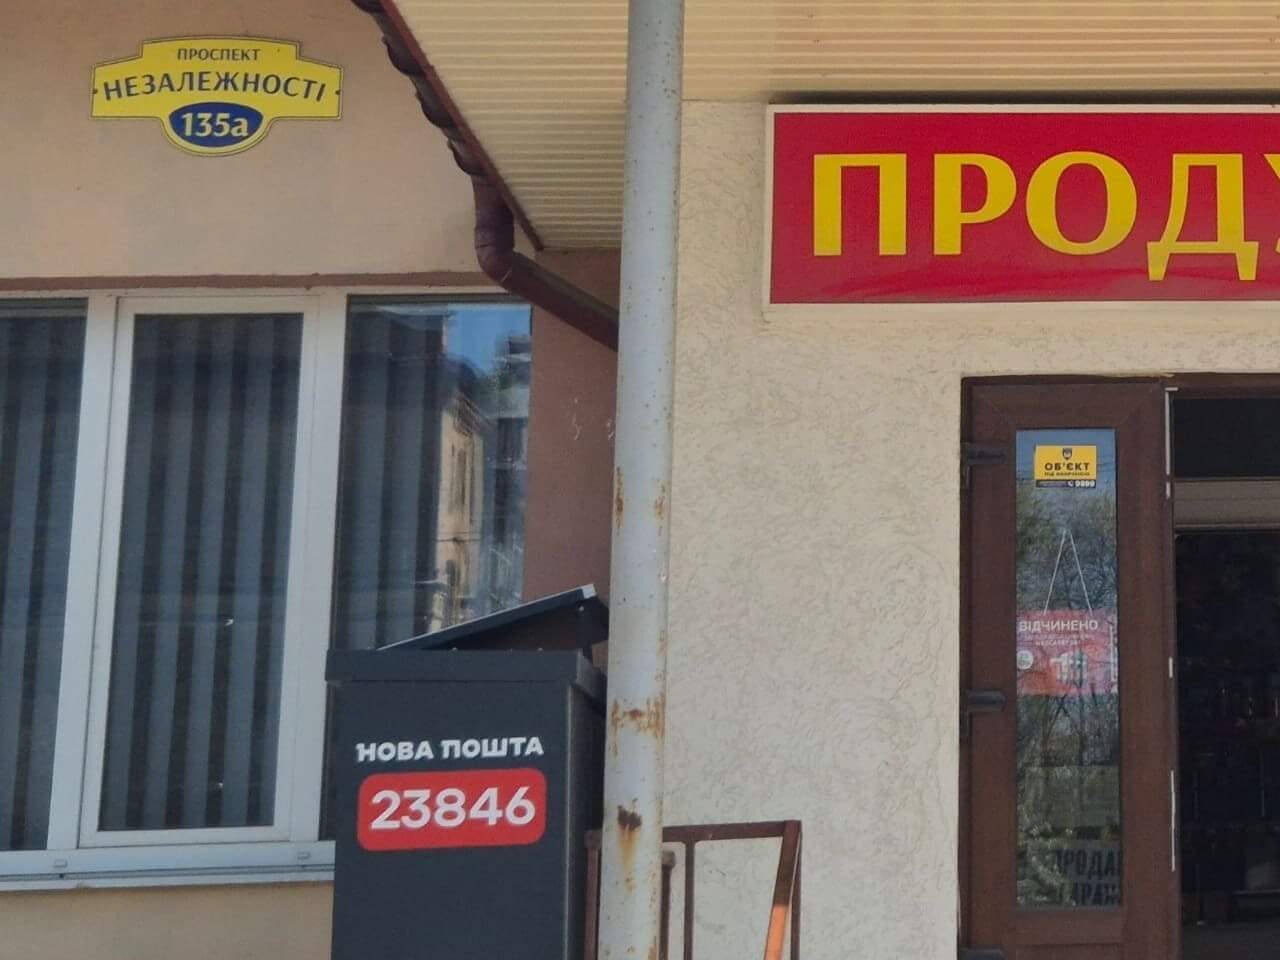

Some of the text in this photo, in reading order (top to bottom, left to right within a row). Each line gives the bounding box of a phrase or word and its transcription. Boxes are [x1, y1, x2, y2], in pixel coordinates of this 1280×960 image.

[177, 48, 261, 61] ПРОСПЕКТ
[103, 71, 326, 102] НЕЗАЛЕЖНОСТІ
[181, 112, 249, 138] 135а
[1019, 619, 1099, 633] ВІДЧИНЕНО
[355, 737, 545, 763] НОВА ПОШТА
[370, 786, 537, 831] 23846
